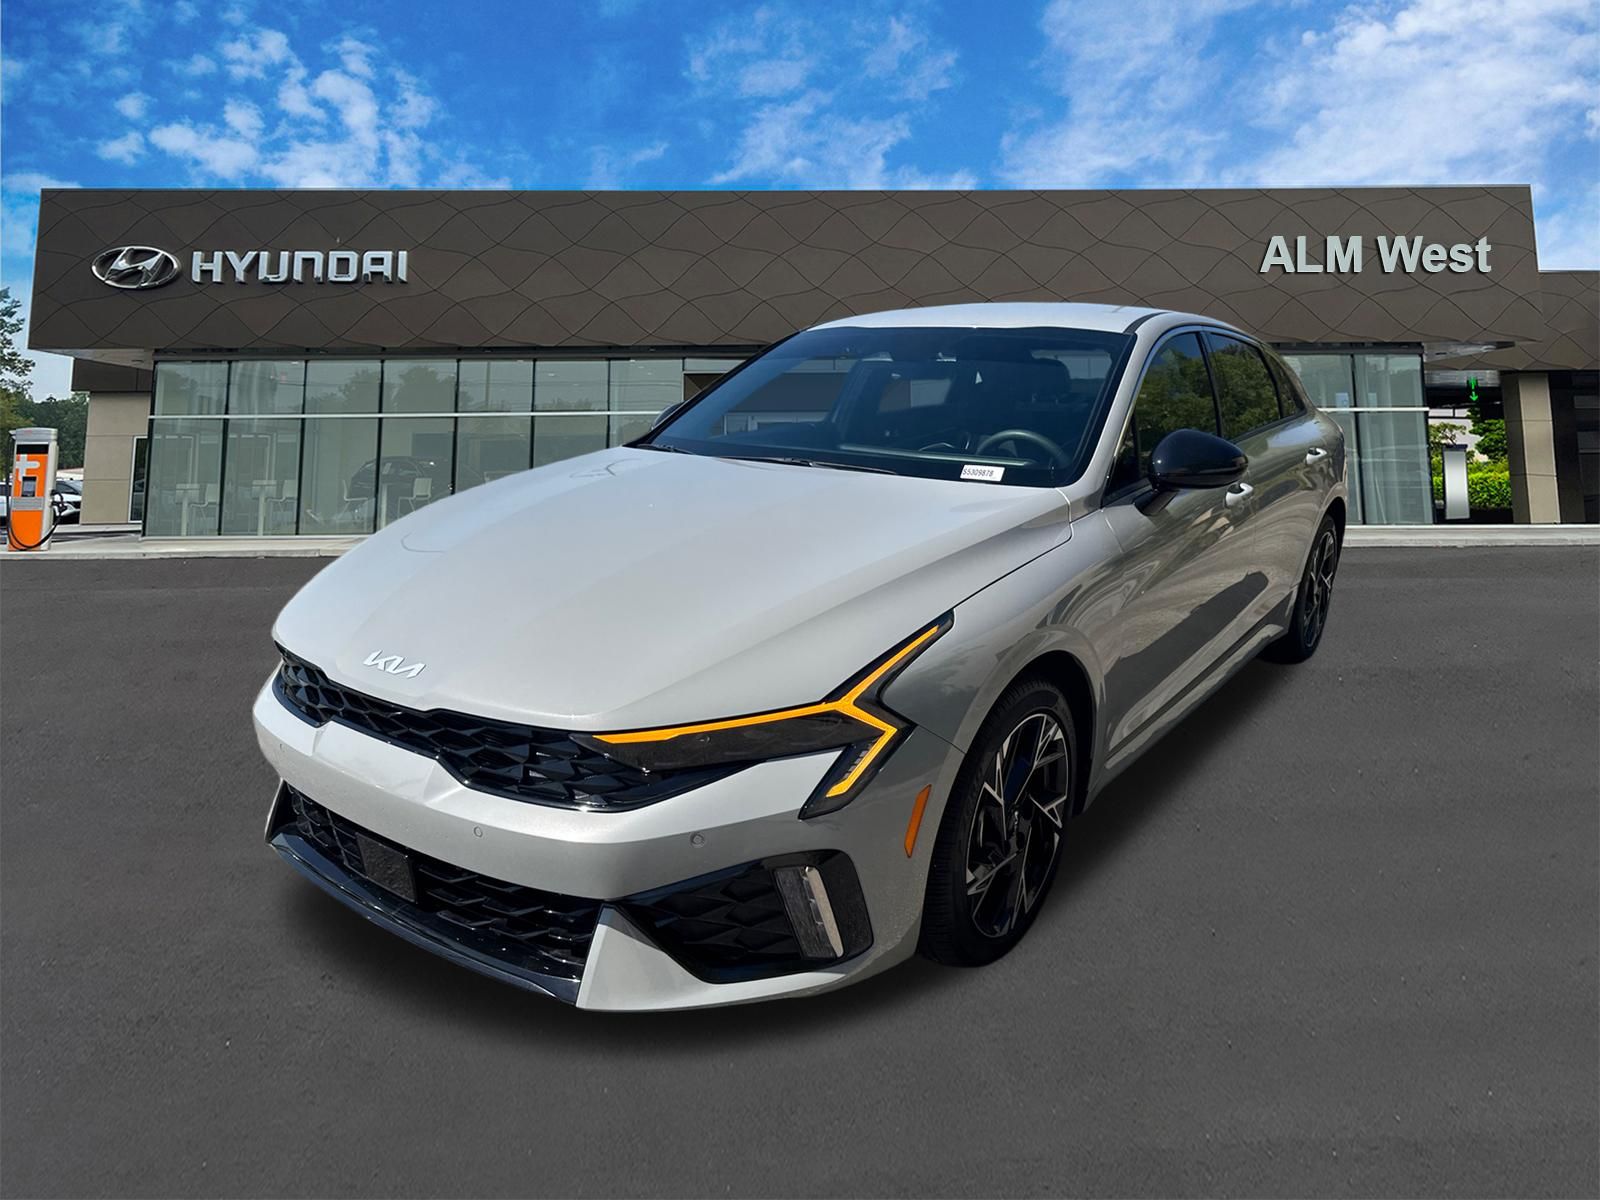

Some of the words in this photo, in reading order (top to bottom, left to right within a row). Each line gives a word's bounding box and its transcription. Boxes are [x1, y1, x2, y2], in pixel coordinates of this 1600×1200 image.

[191, 250, 408, 283] HYUNDAI
[1260, 235, 1363, 273] ALM
[1377, 235, 1492, 273] West
[363, 649, 426, 679] KIA
